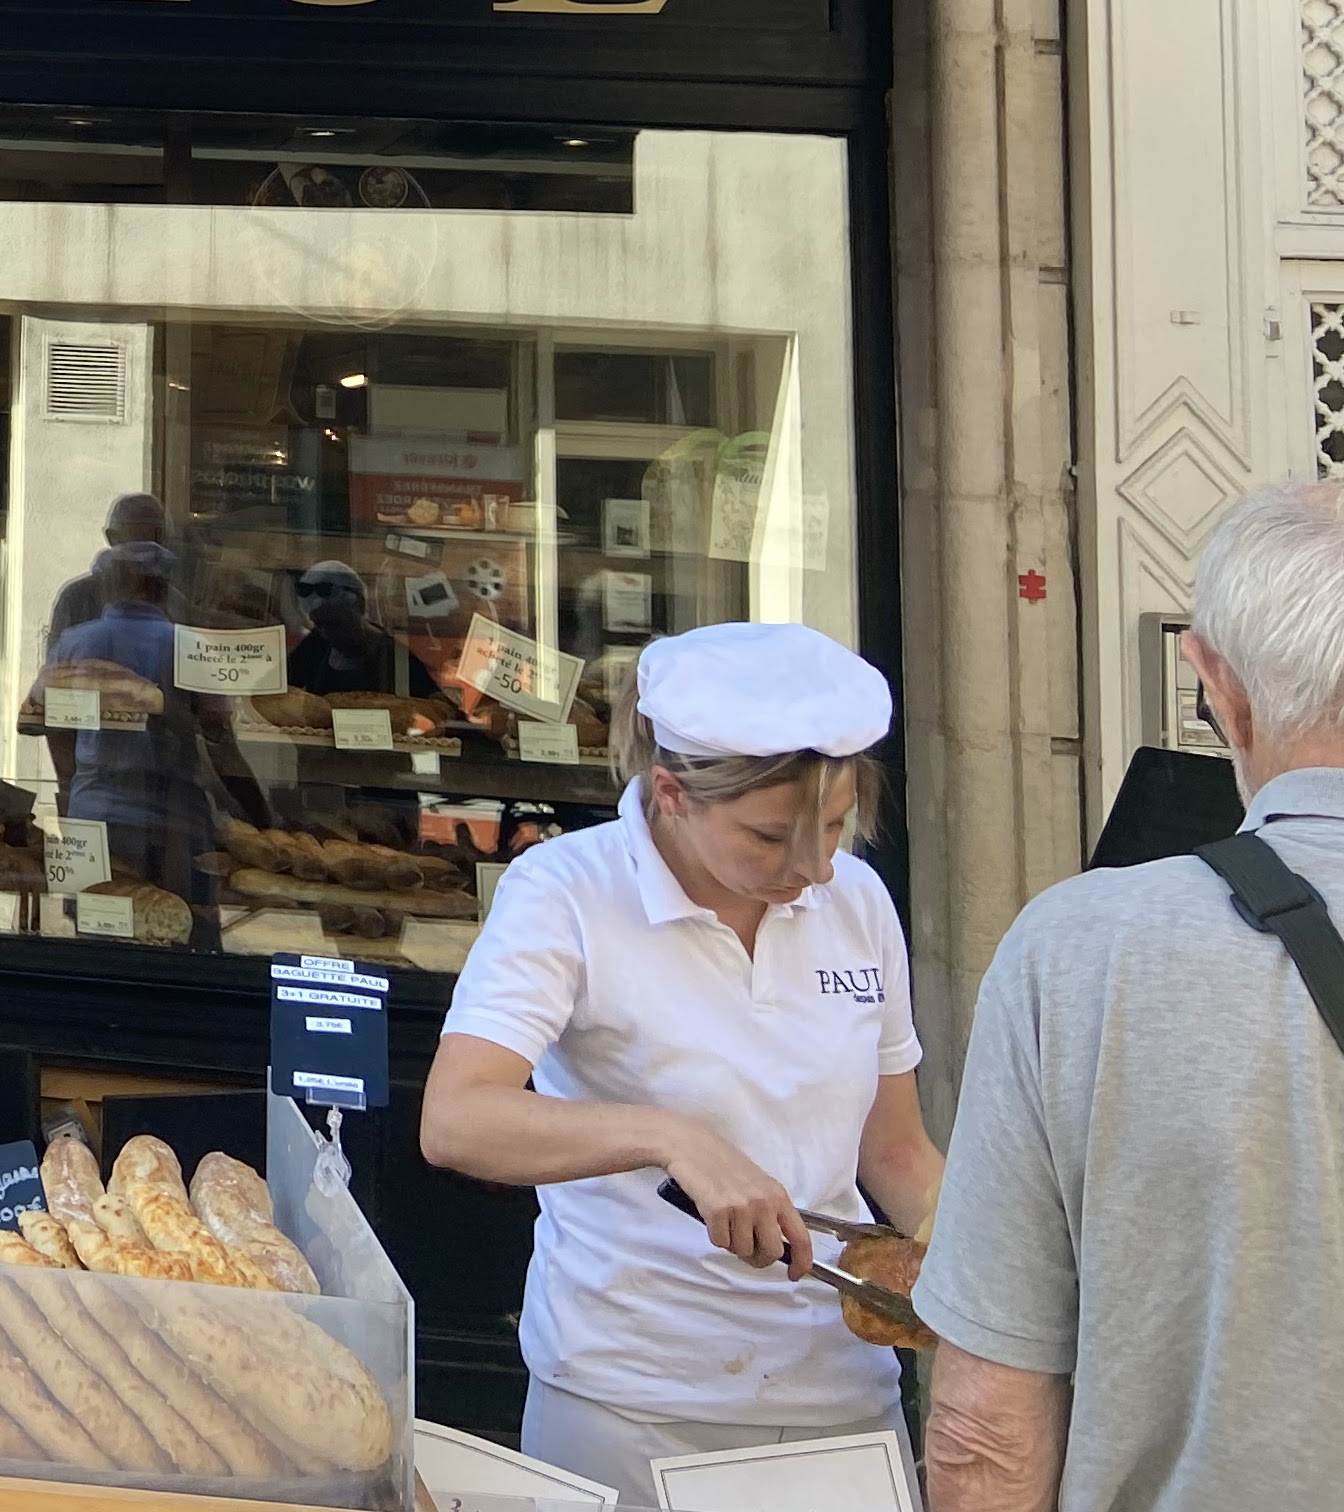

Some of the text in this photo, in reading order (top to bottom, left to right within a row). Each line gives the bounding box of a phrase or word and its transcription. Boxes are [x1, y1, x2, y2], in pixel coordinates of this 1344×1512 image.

[205, 641, 231, 653] pain
[233, 641, 265, 653] 400gr
[496, 643, 522, 661] pain
[186, 652, 224, 664] acheté
[226, 653, 237, 665] le
[303, 958, 351, 971] OFFRE
[272, 967, 386, 989] BAGUETTE PAUL
[814, 967, 885, 994] PAUL
[280, 989, 379, 1007] 3+1 GRATUITE
